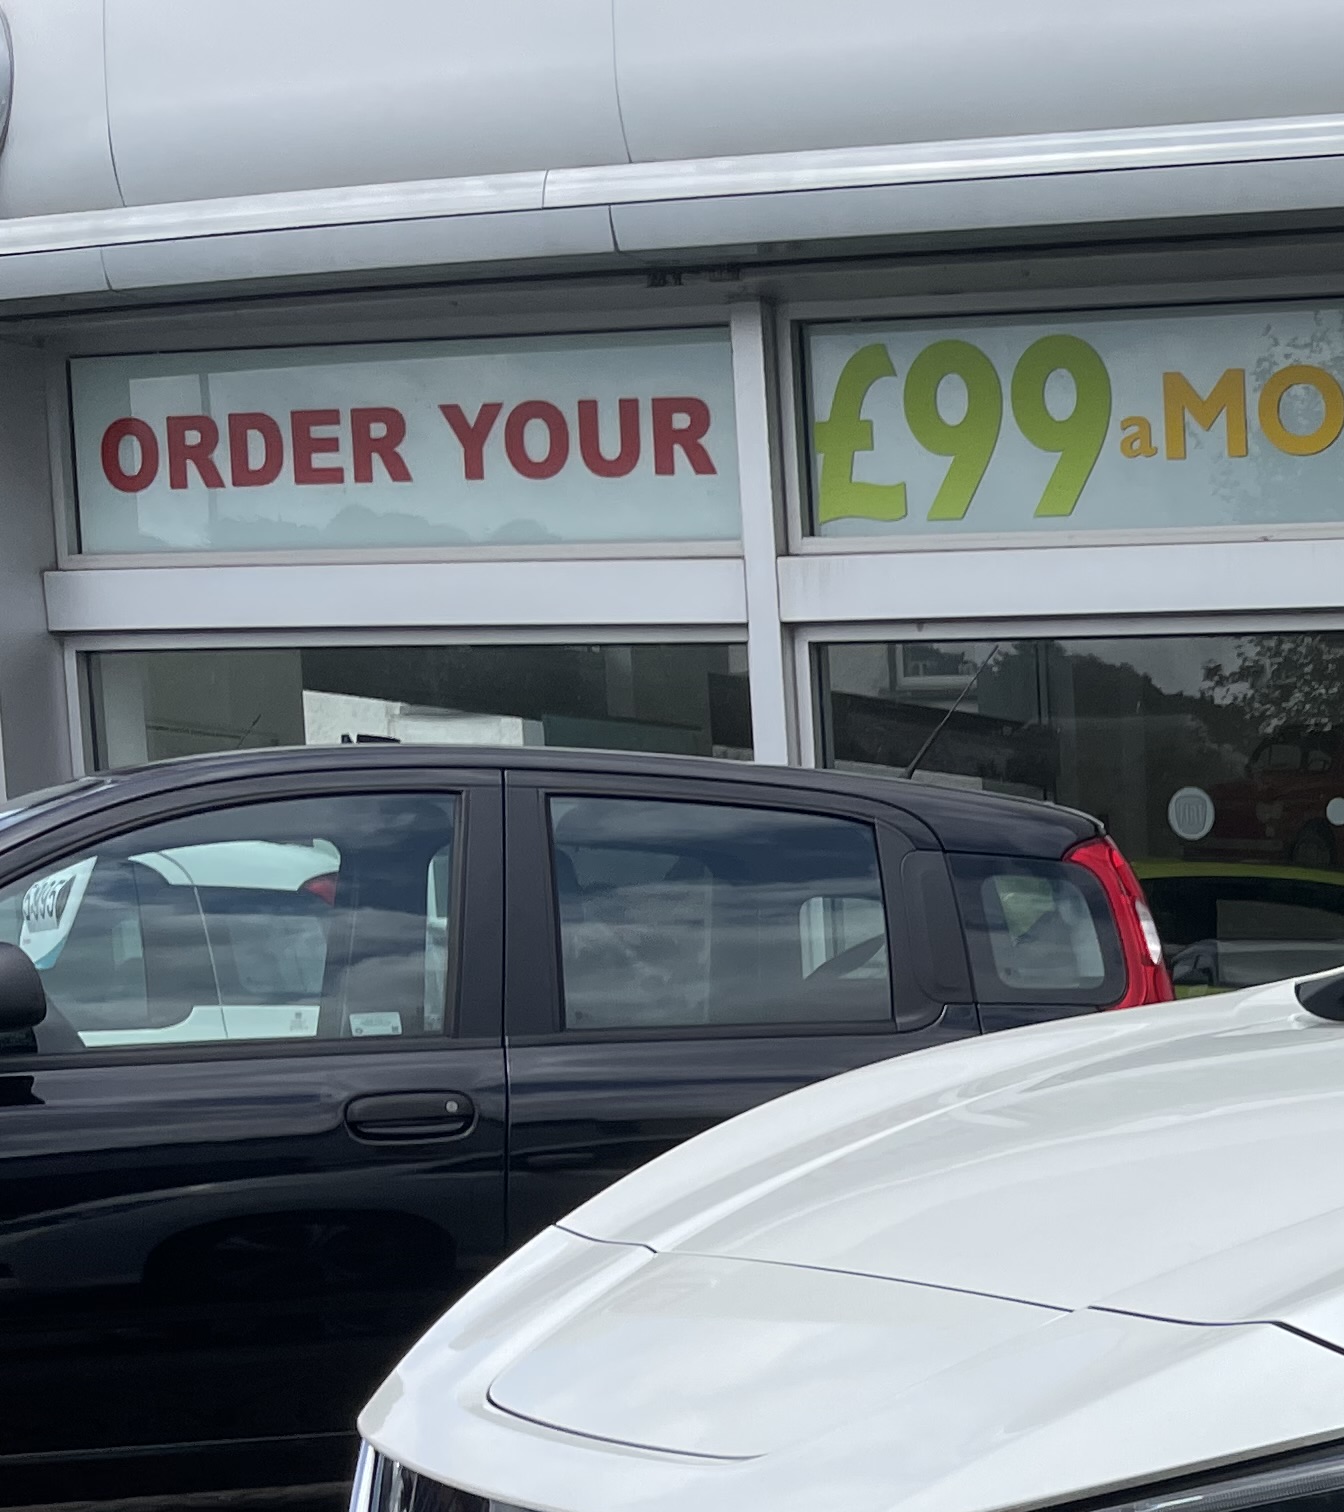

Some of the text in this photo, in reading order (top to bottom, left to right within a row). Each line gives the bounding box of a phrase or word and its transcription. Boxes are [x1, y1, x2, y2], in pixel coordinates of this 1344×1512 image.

[101, 396, 718, 493] ORDER YOUR
[814, 334, 1113, 524] £99
